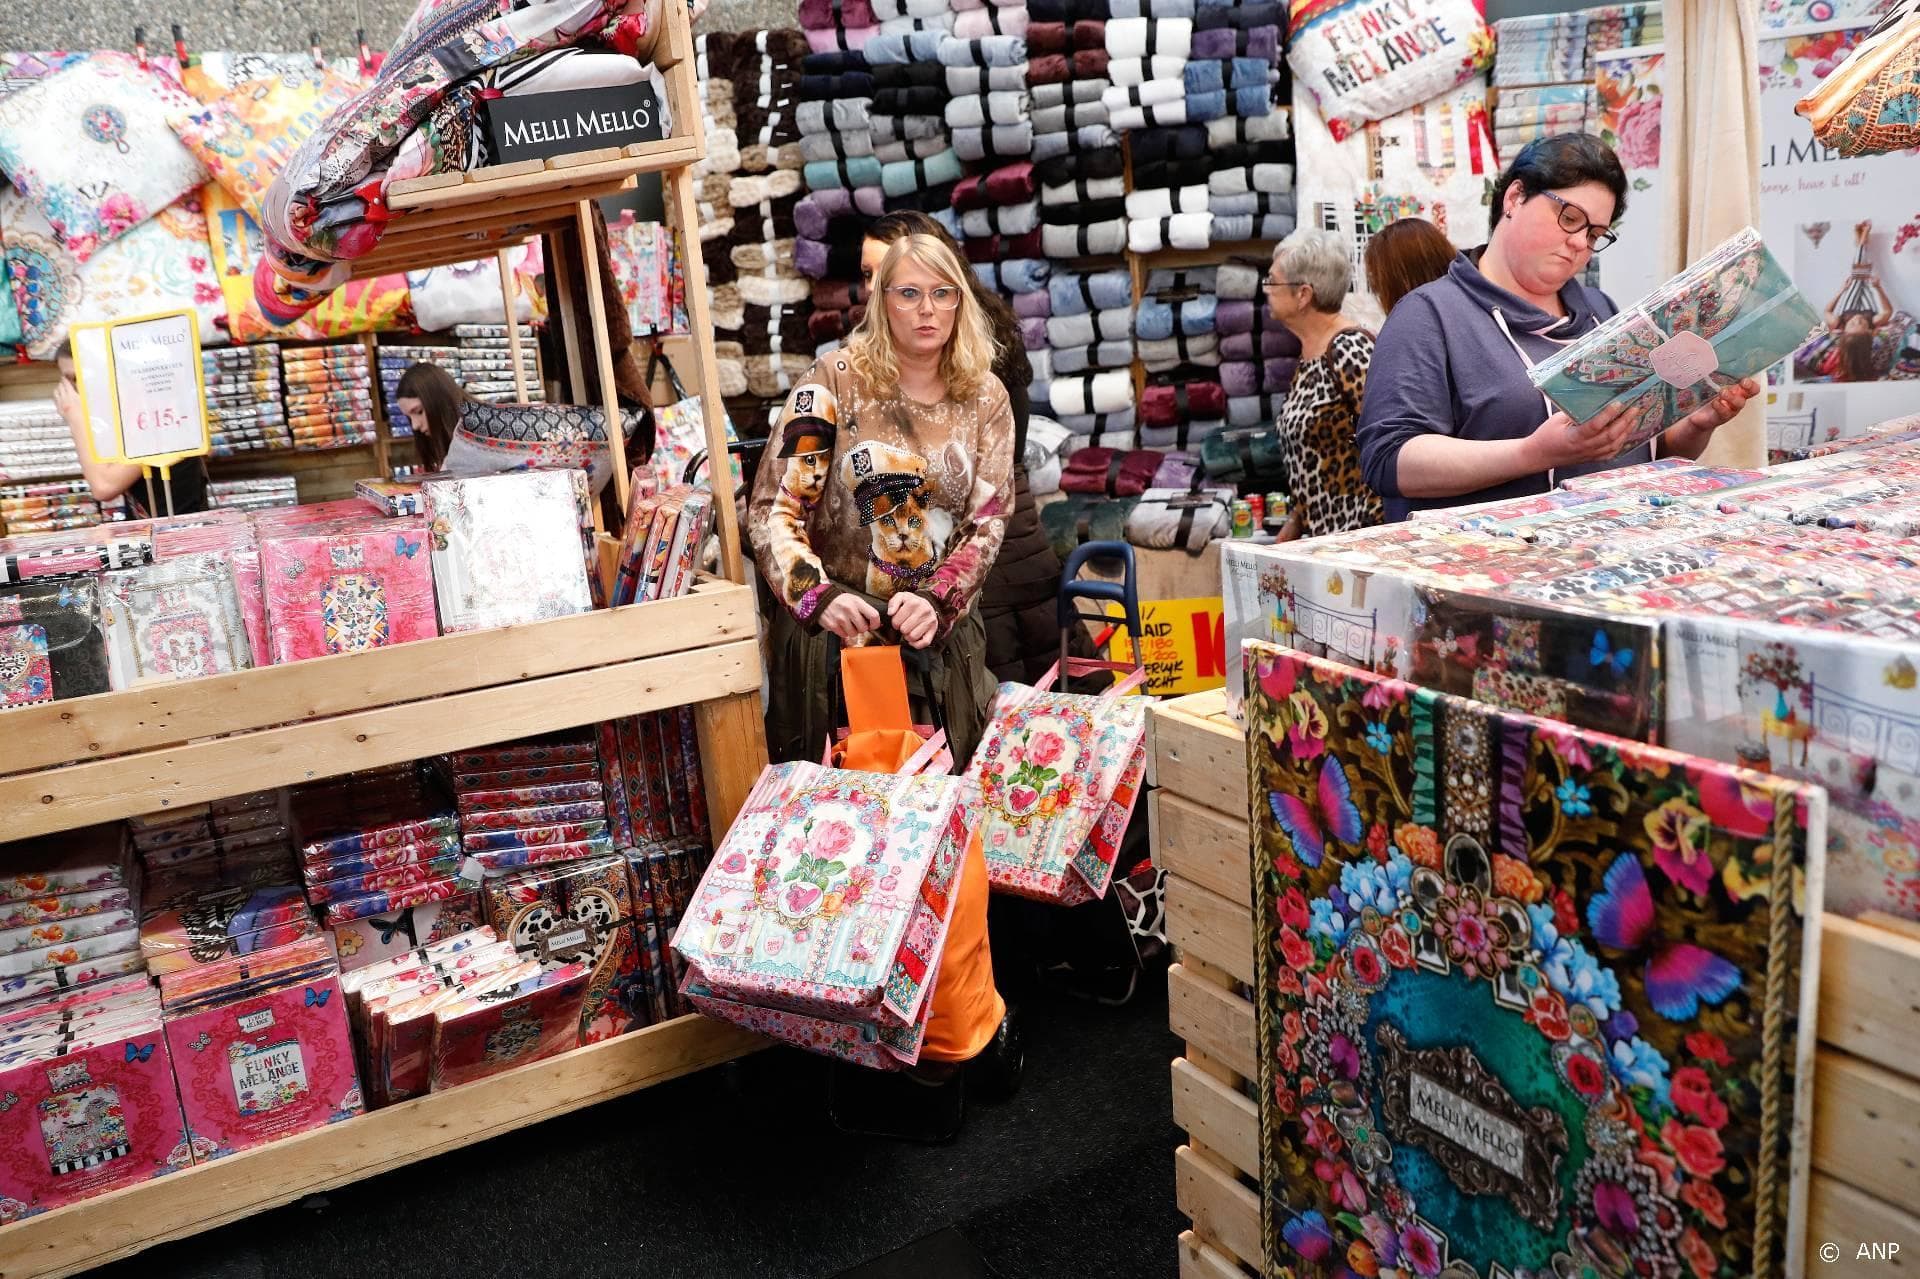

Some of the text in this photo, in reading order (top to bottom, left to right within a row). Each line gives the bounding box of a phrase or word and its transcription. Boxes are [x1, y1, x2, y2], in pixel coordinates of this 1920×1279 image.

[1322, 16, 1456, 97] MELANGE
[504, 118, 571, 147] MELLI
[240, 1061, 300, 1090] MELANGE
[243, 1050, 290, 1073] FUNKY
[1416, 1090, 1518, 1159] MELLI MELLO
